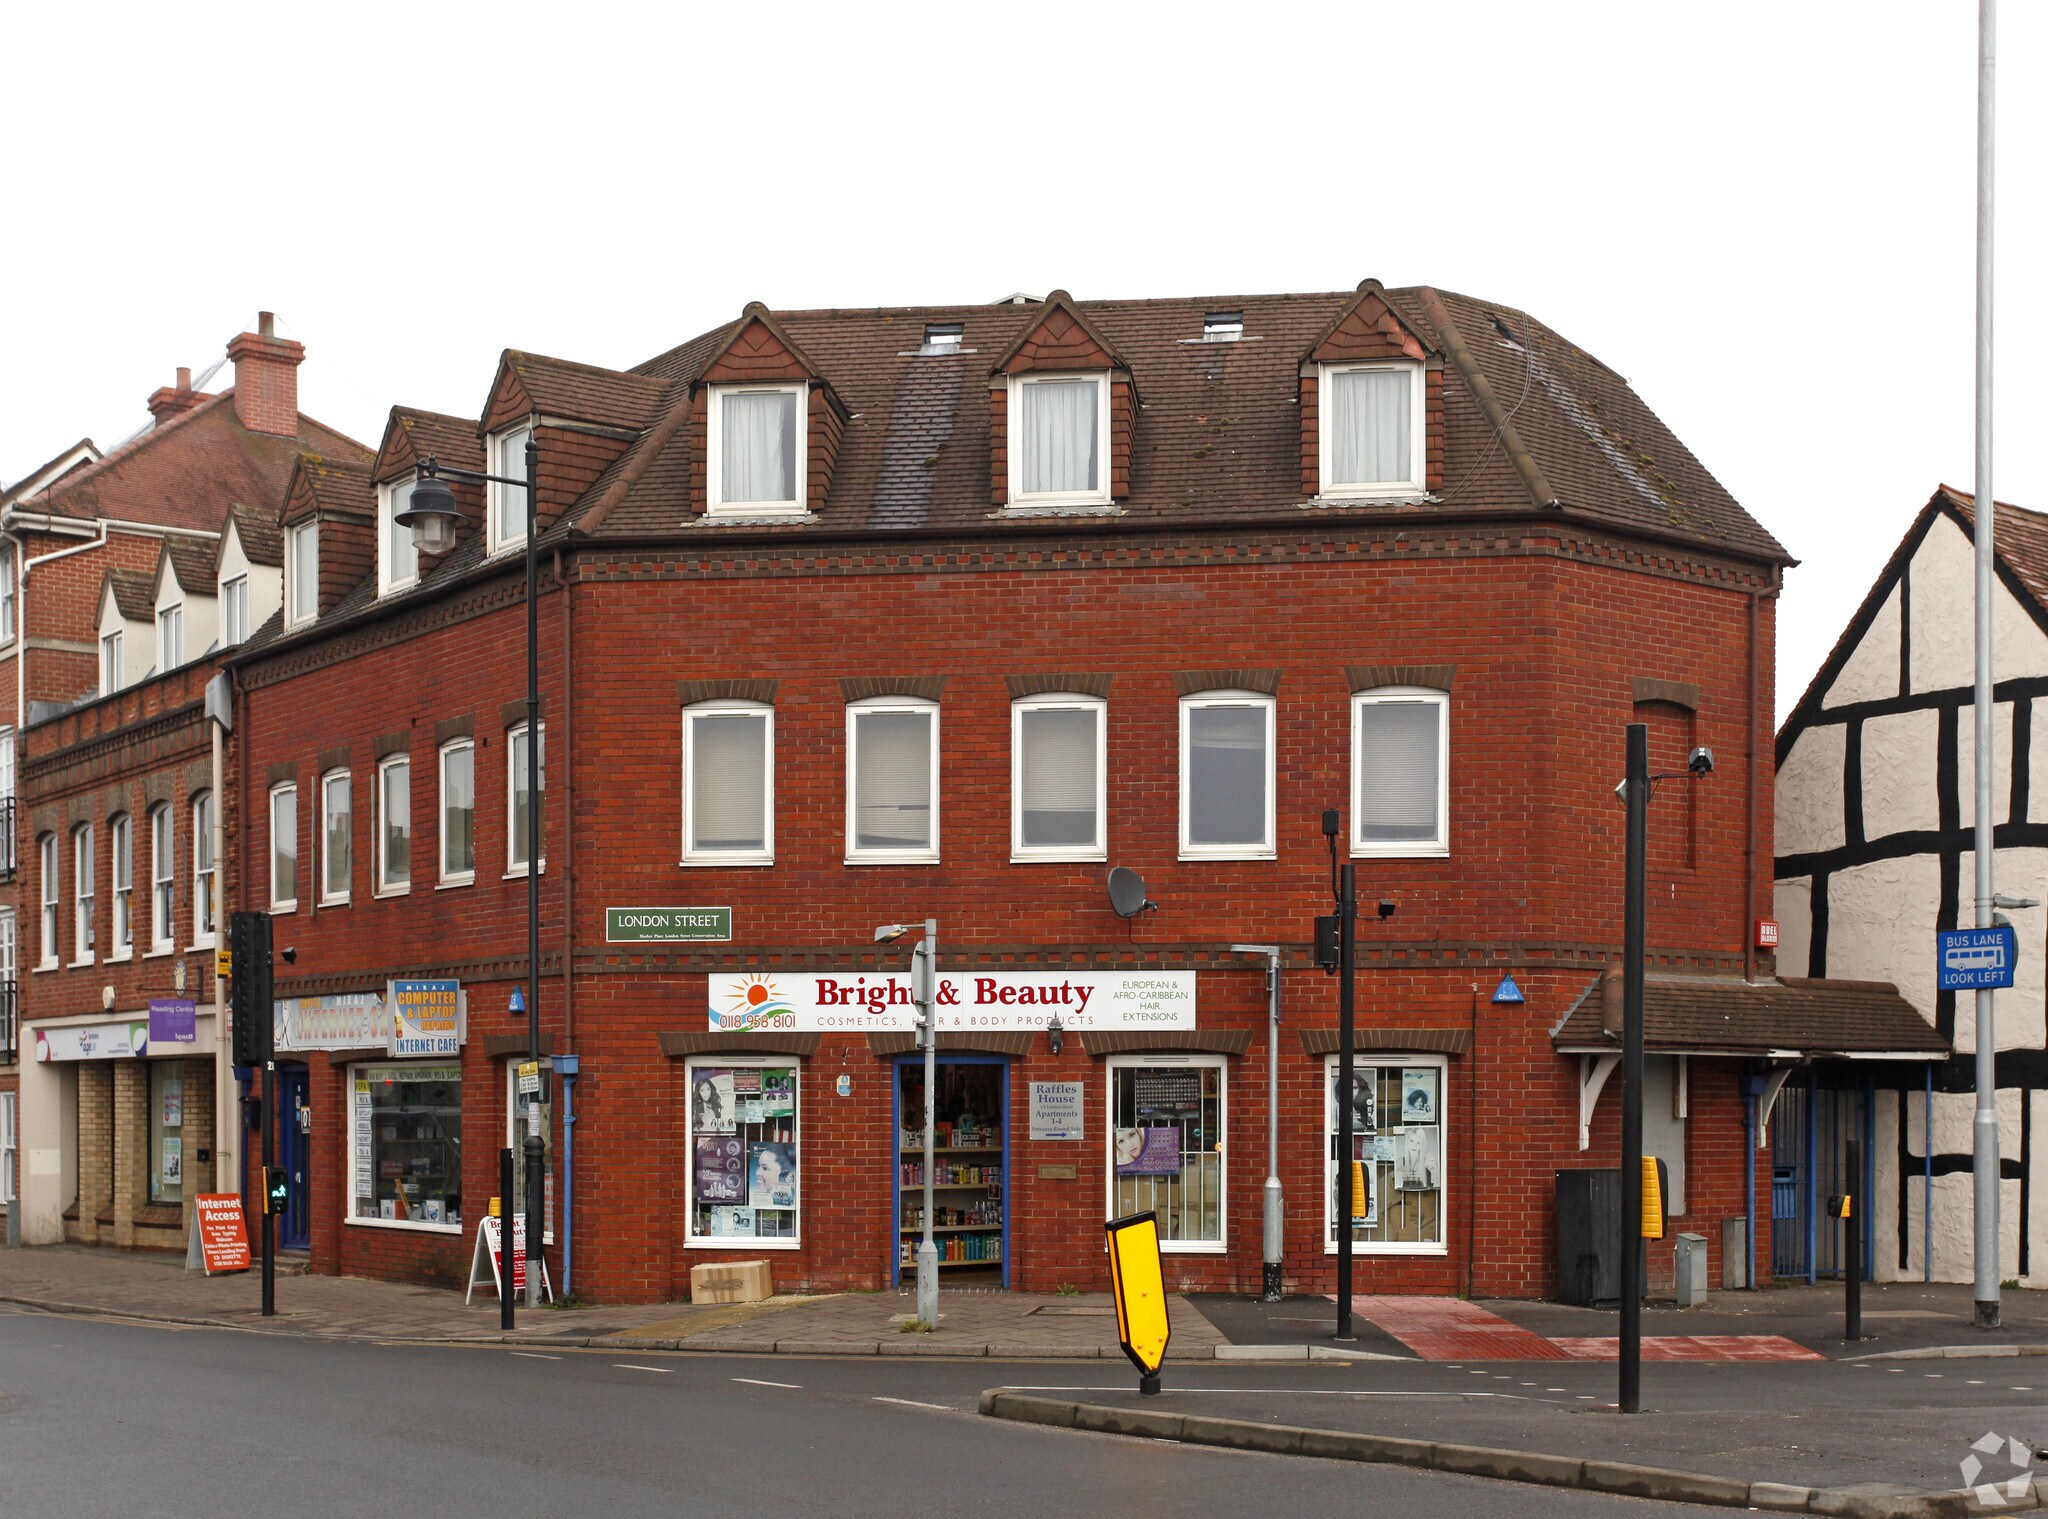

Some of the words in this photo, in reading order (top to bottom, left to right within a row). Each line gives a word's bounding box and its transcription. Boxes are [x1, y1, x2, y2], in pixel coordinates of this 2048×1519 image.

[618, 915, 669, 927] LONDON
[675, 914, 720, 927] STREET
[1761, 925, 1777, 935] ABEL
[1946, 936, 1969, 947] BUS
[1973, 934, 2004, 946] LANE
[1945, 972, 1975, 984] LOOK
[1978, 971, 2005, 983] LEFT
[1122, 981, 1169, 989] EUROPEAN
[1171, 981, 1178, 989] &
[336, 995, 364, 1006] MIRAJ
[397, 991, 456, 1005] COMPUTER
[935, 980, 961, 1005] &
[974, 978, 1095, 1014] Beauty
[1112, 991, 1189, 1000] AFRO-CARIBBEAN
[151, 1005, 175, 1014] Reading
[175, 1005, 194, 1013] Centre
[1139, 1002, 1160, 1010] HAIR
[407, 1007, 415, 1019] &
[417, 1005, 456, 1019] LAPTOP
[1122, 1012, 1178, 1021] EXTENSIONS
[421, 1020, 456, 1031] REPAIRS
[719, 1014, 742, 1029] 0118
[746, 1014, 769, 1029] 958
[773, 1014, 796, 1029] 8101
[912, 1017, 945, 1026] HR
[954, 1016, 961, 1026] &
[971, 1016, 1008, 1026] BODY
[1017, 1016, 1094, 1026] PRODUCTS
[396, 1038, 435, 1053] INTERNET
[437, 1038, 457, 1052] CAFE
[1036, 1084, 1077, 1094] Raffles
[1038, 1094, 1075, 1103] House
[1036, 1110, 1078, 1120] Apartments
[198, 1198, 242, 1210] Internet
[205, 1210, 240, 1221] Access
